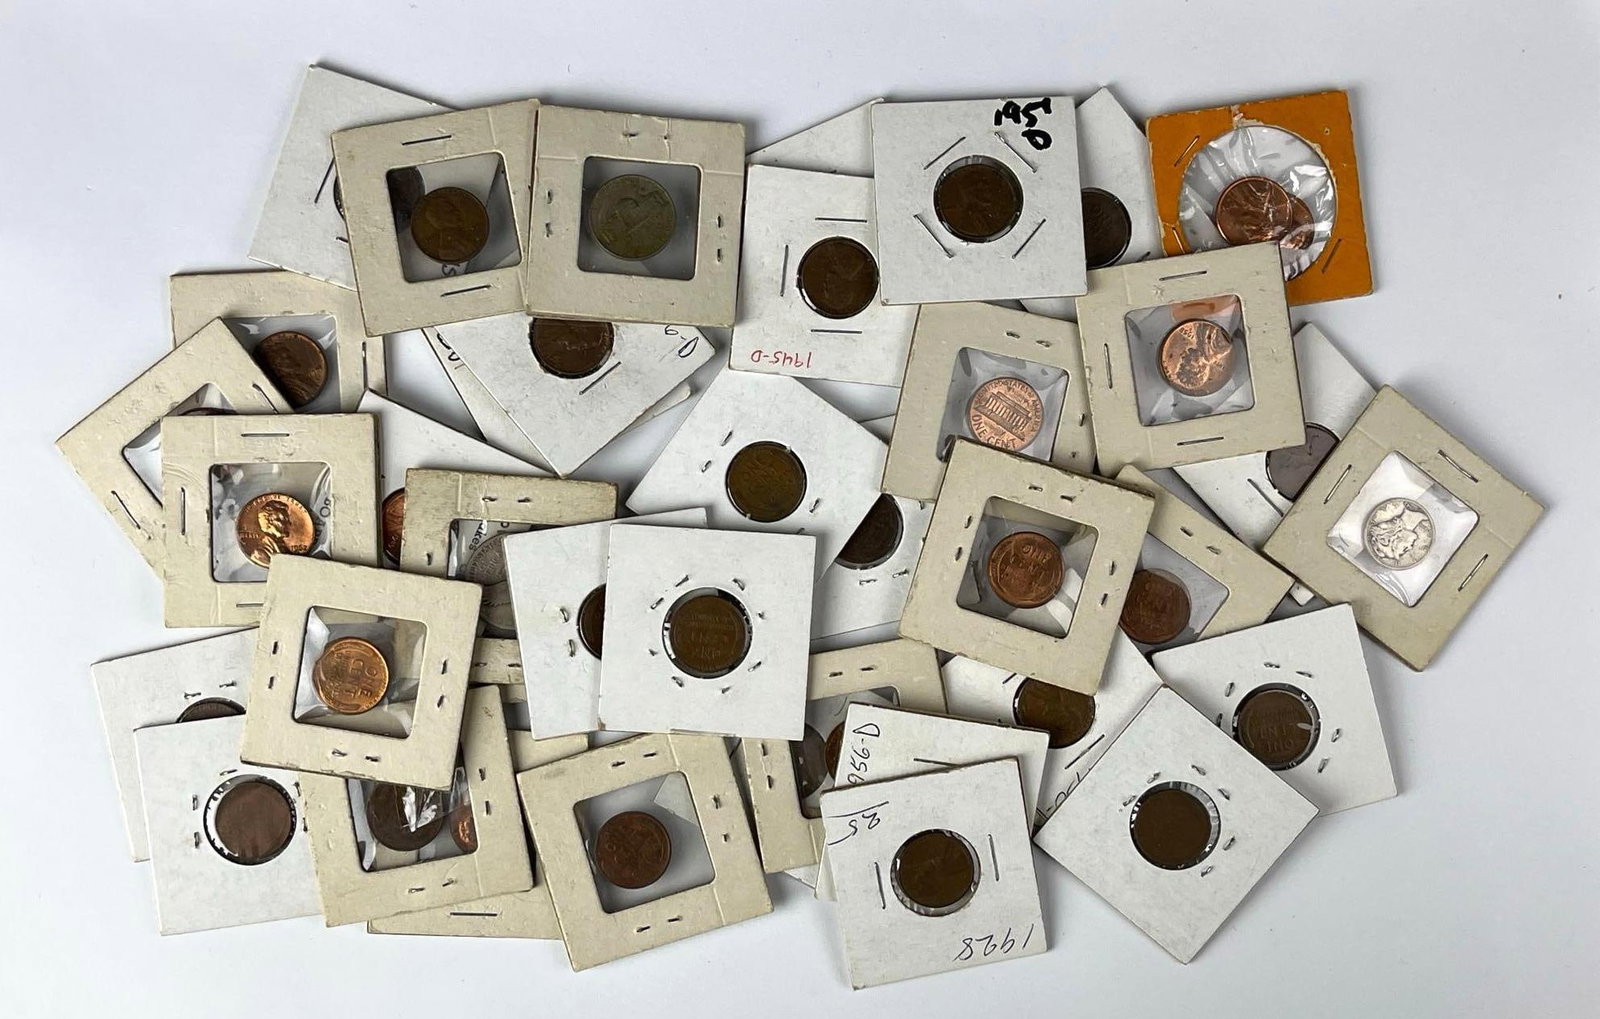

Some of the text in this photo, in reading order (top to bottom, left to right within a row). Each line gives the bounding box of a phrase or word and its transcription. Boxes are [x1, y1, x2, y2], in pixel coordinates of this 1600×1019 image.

[750, 349, 812, 369] 1945-D
[972, 414, 988, 439] ONE
[952, 923, 1034, 962] 1928
